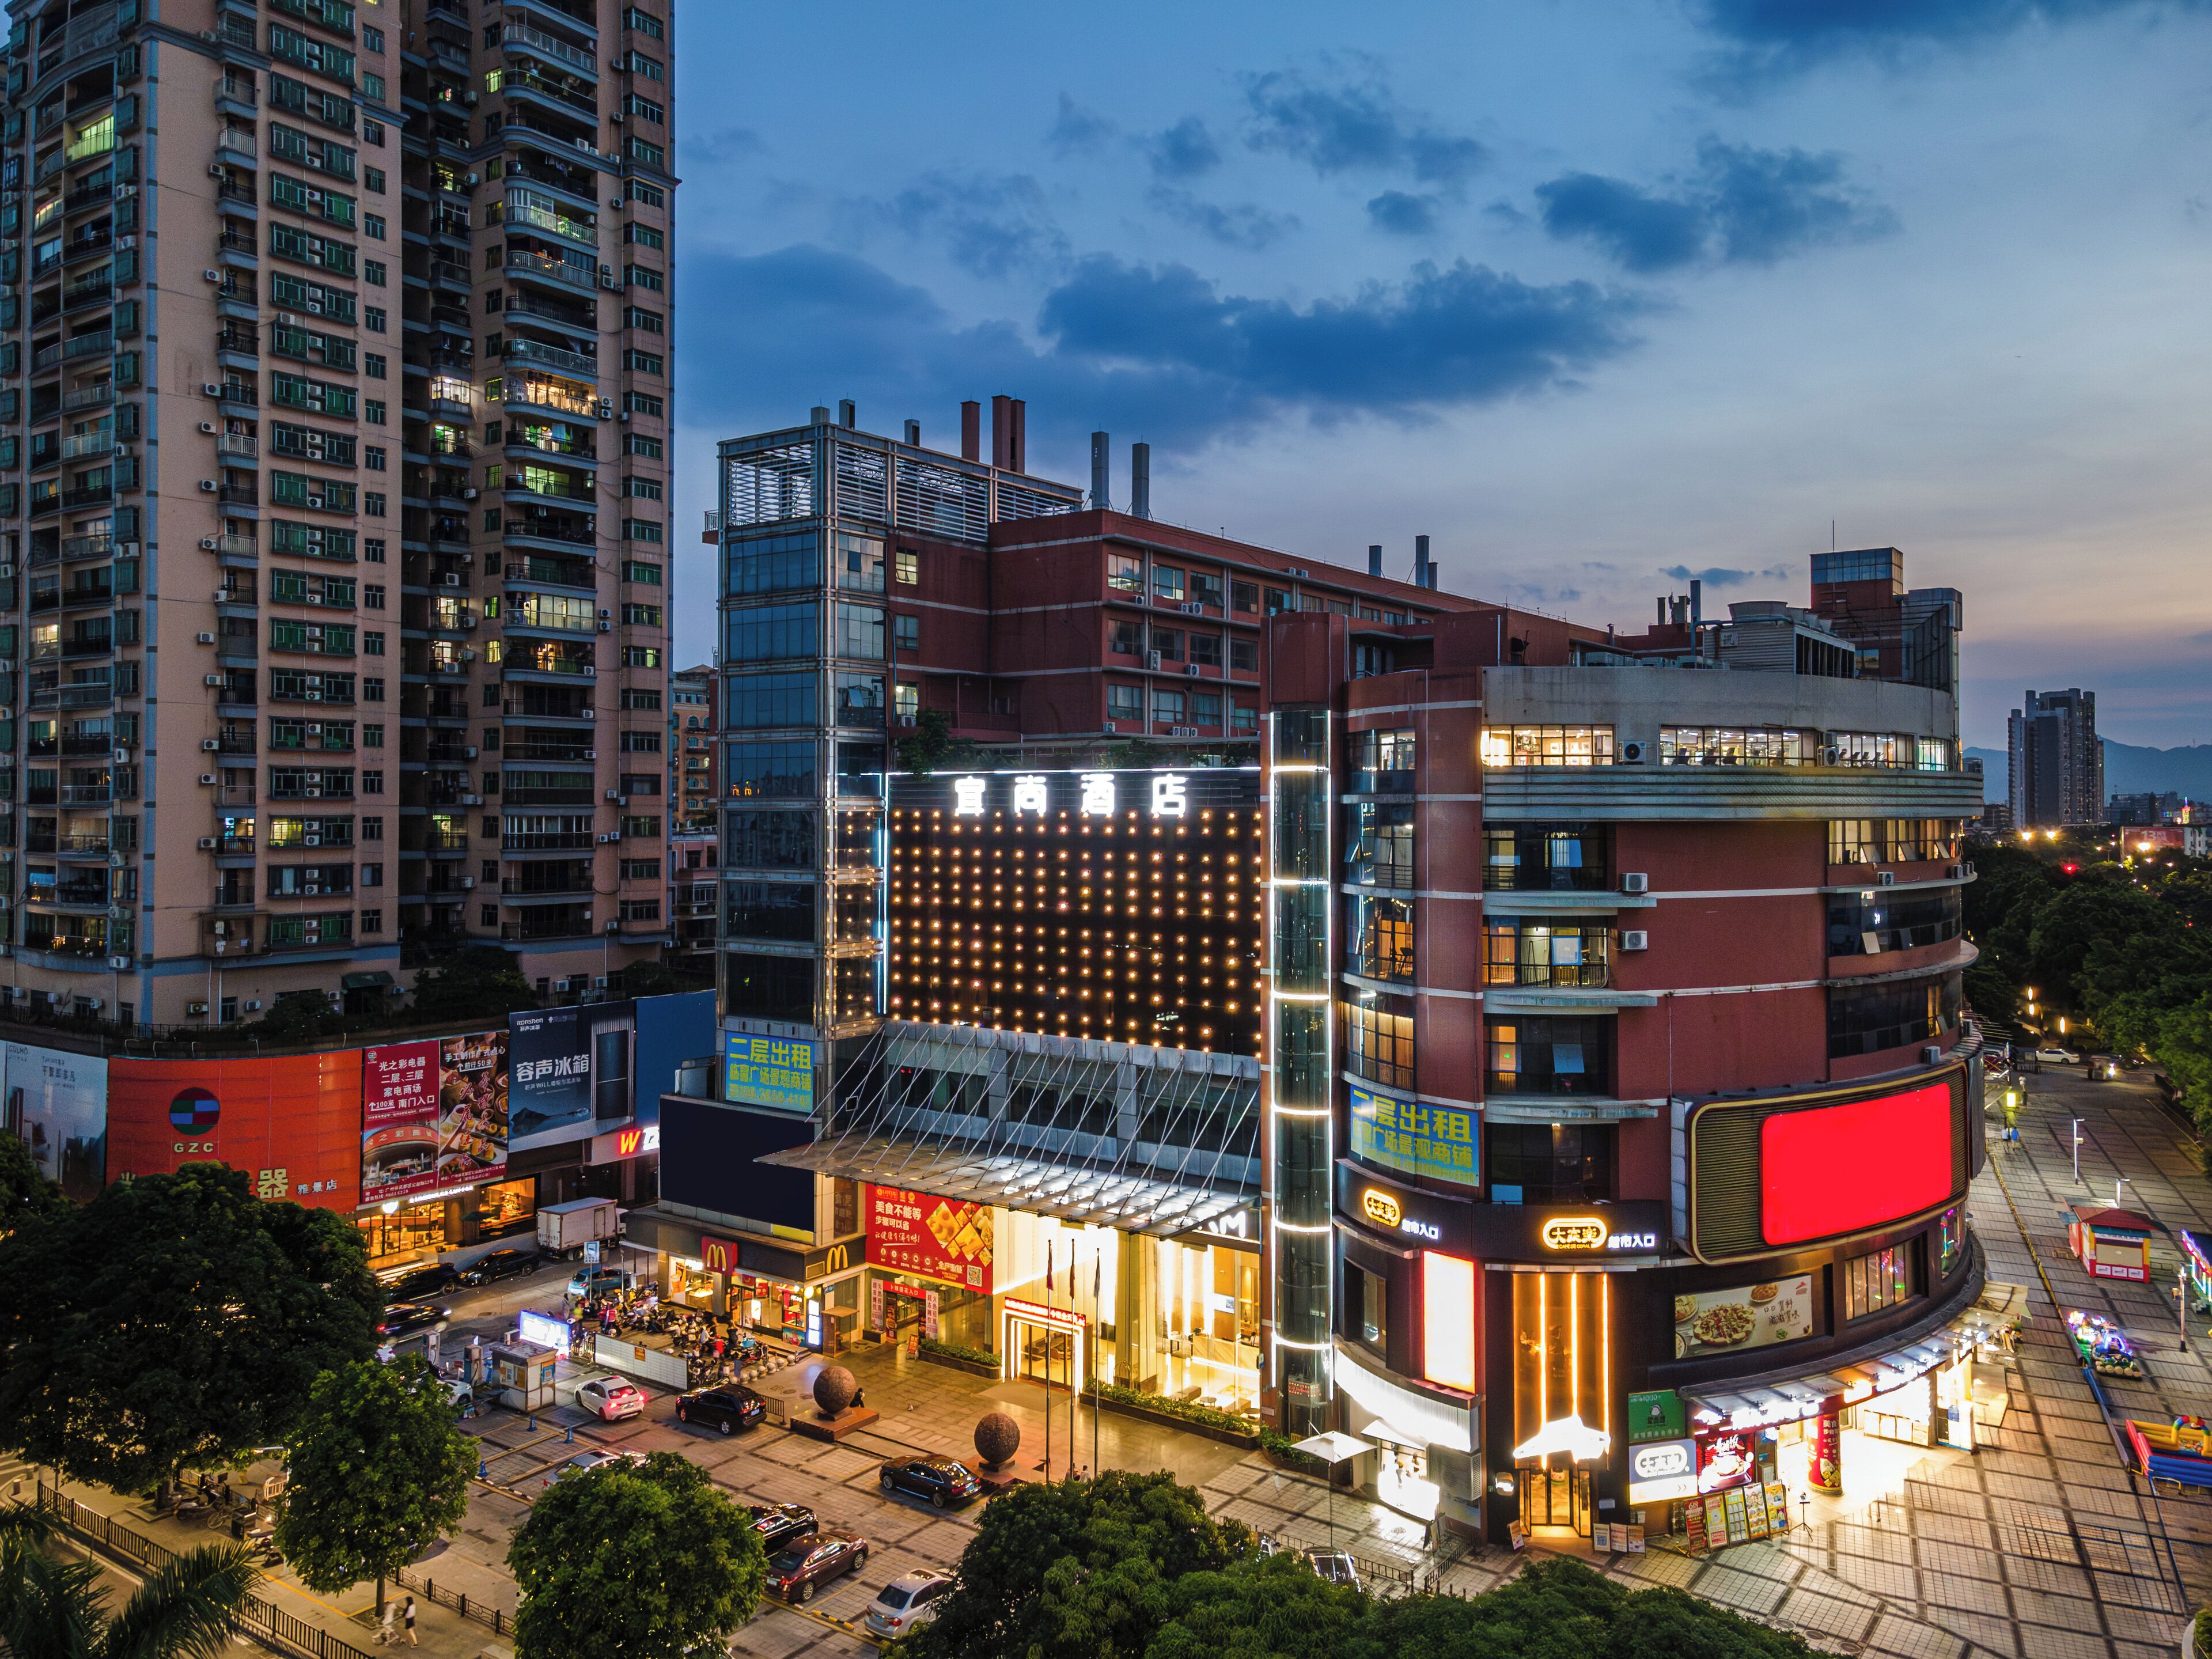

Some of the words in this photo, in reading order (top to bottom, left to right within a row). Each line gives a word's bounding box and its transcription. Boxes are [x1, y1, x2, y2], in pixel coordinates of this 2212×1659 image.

[729, 1038, 812, 1070] 二层出租
[379, 1056, 426, 1072] 光之彩电器
[516, 1054, 589, 1082] 容声冰箱
[384, 1084, 422, 1097] 家电商场
[398, 1095, 435, 1109] 南门入口
[1352, 1089, 1472, 1143] 二层出租
[174, 1142, 214, 1153] GZC
[297, 1179, 338, 1195] 雅景店
[875, 1200, 922, 1221] 美食不能等
[875, 1215, 910, 1231] 步骤可以省
